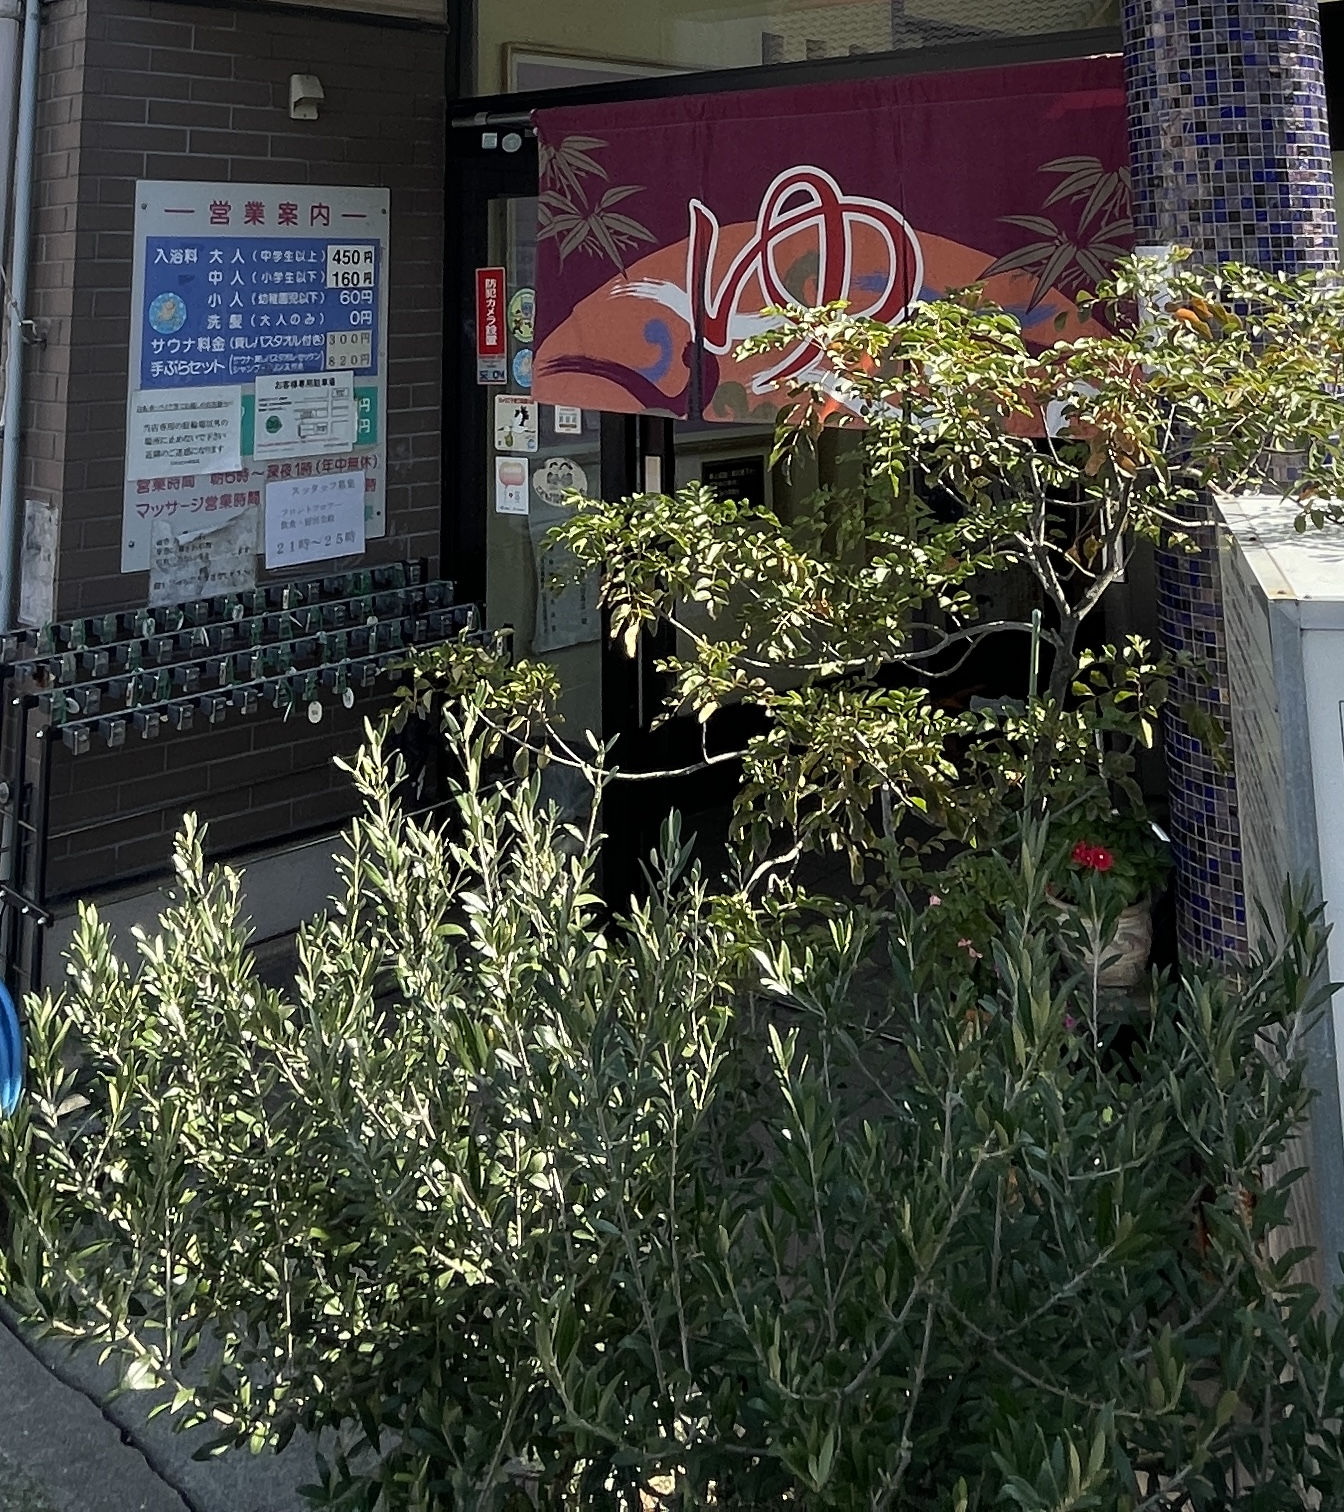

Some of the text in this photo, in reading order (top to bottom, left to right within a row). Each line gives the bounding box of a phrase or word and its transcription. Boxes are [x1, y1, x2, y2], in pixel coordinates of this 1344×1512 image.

[209, 200, 330, 227] 営業案内
[154, 248, 198, 264] 入浴料
[209, 249, 245, 264] 大人
[332, 249, 373, 264] 450円
[208, 271, 245, 285] 中人
[332, 272, 372, 287] 160円
[689, 165, 925, 394] ゆ
[208, 292, 243, 307] 小人
[340, 290, 373, 305] 60円
[350, 310, 372, 325] 0円
[151, 336, 225, 354] サウナ料金
[328, 332, 370, 345] 300円
[151, 360, 225, 377] 手ぶらセット
